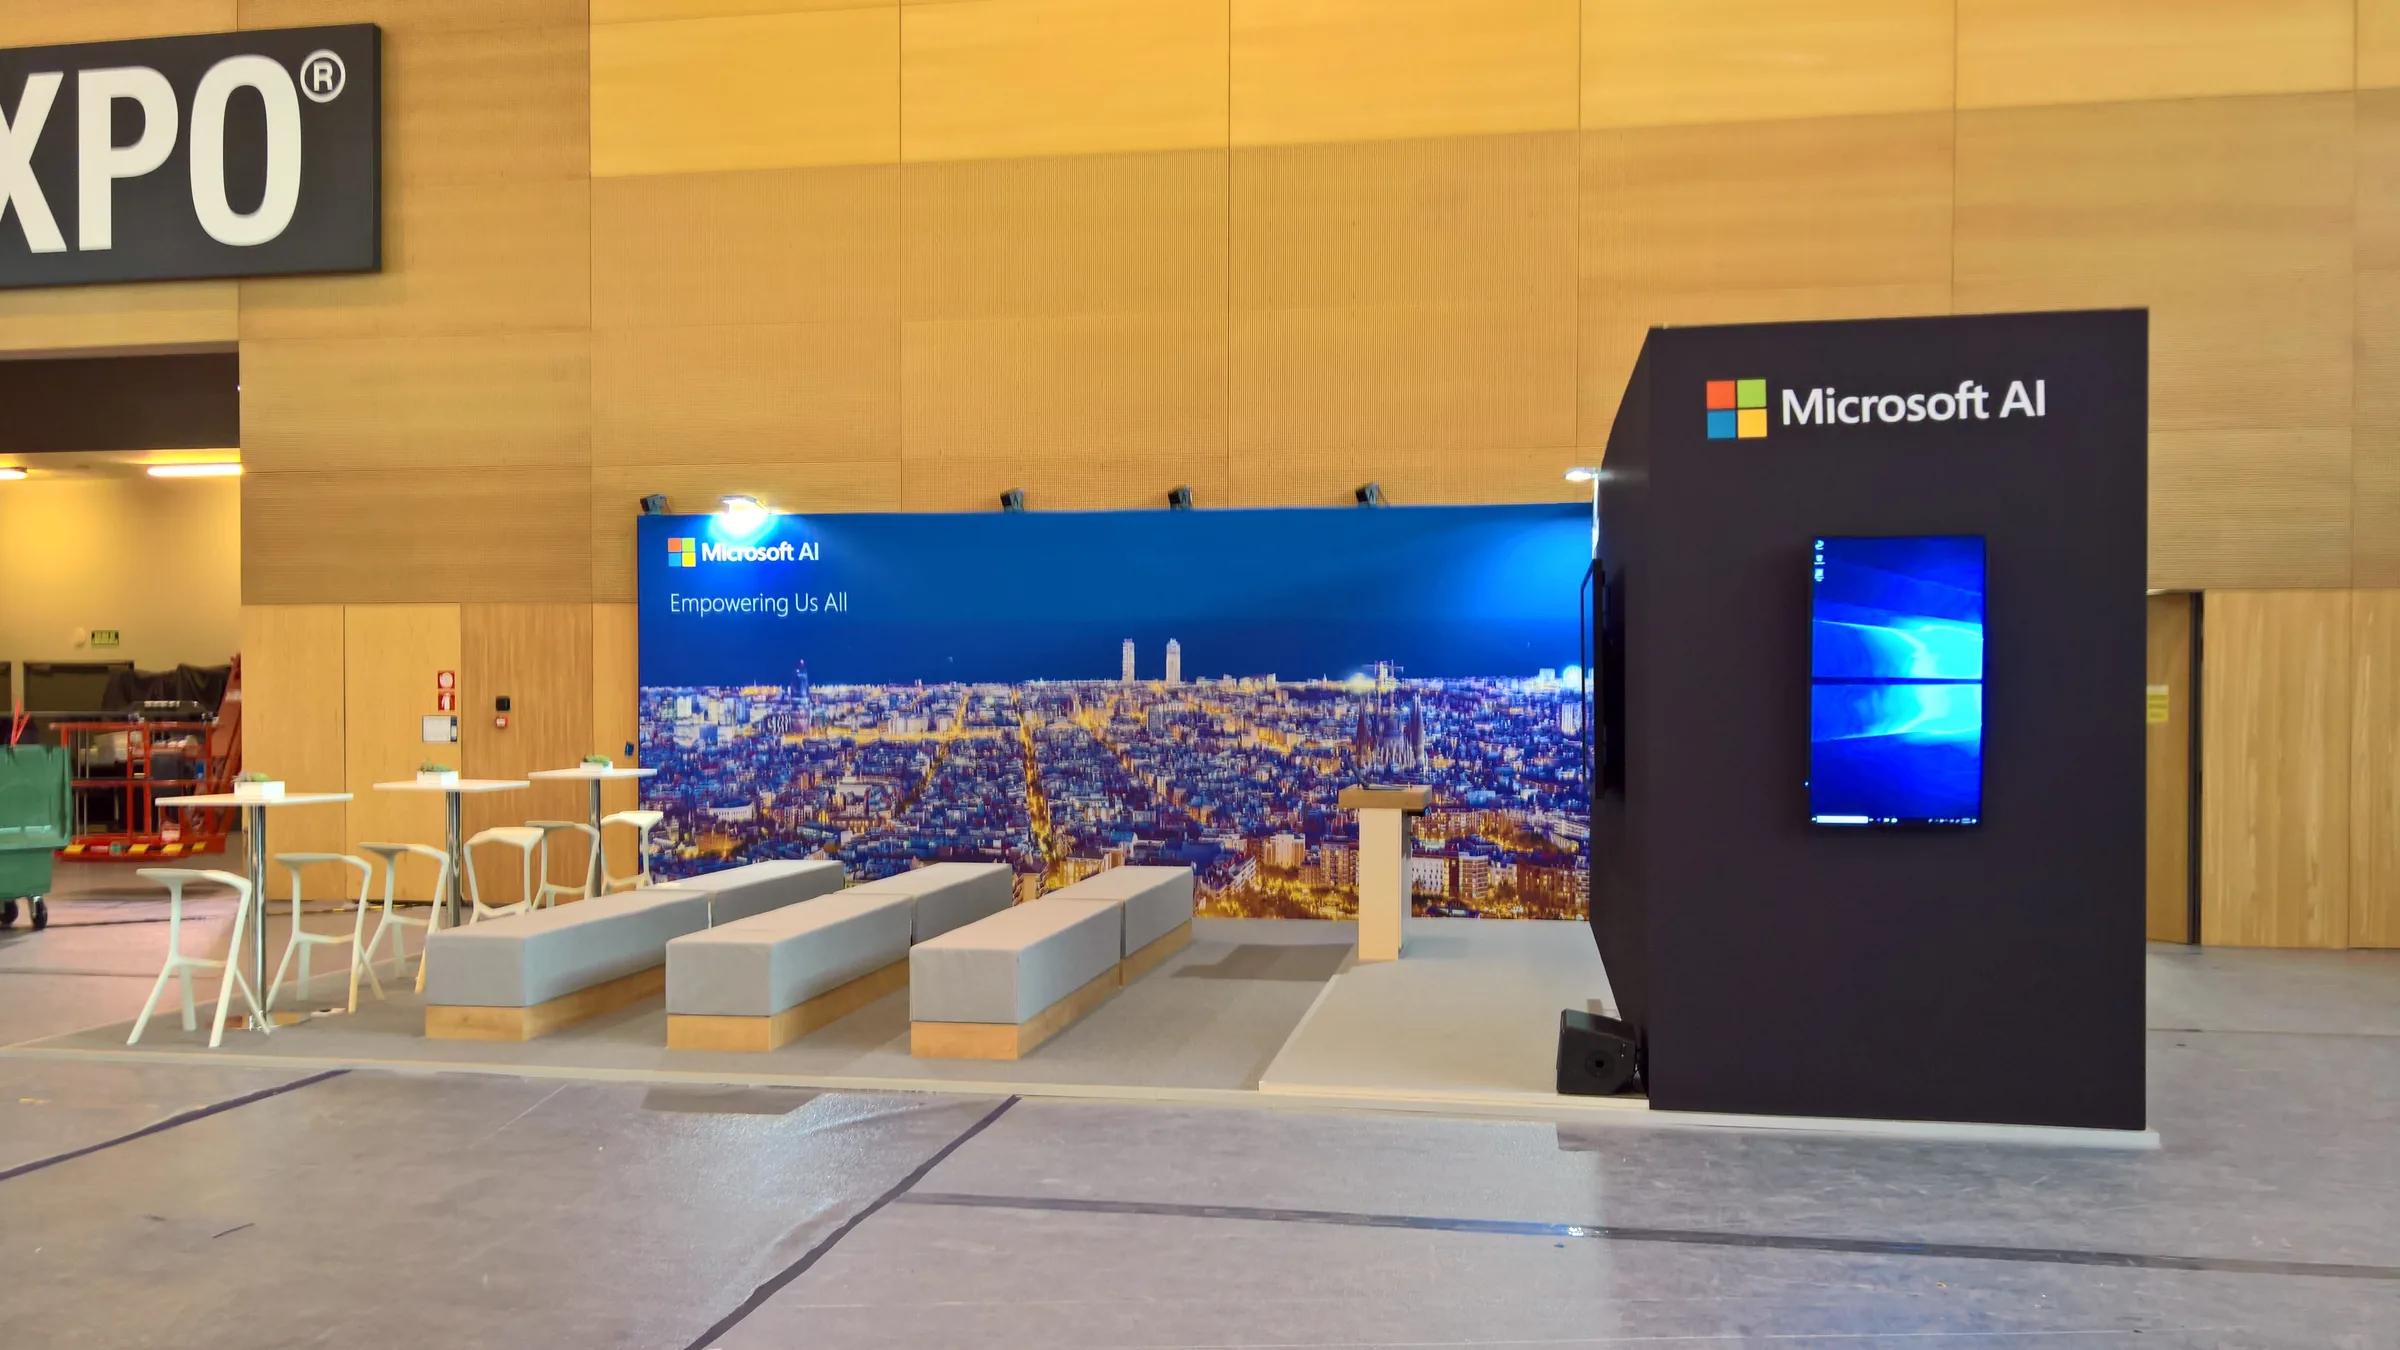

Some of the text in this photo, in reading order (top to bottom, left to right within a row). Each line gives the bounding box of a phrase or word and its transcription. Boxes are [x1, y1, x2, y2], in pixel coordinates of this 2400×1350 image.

[1782, 379, 2047, 426] Microsoft AI
[701, 540, 819, 562] Microsoft AI
[670, 591, 848, 618] Empowering Us All
